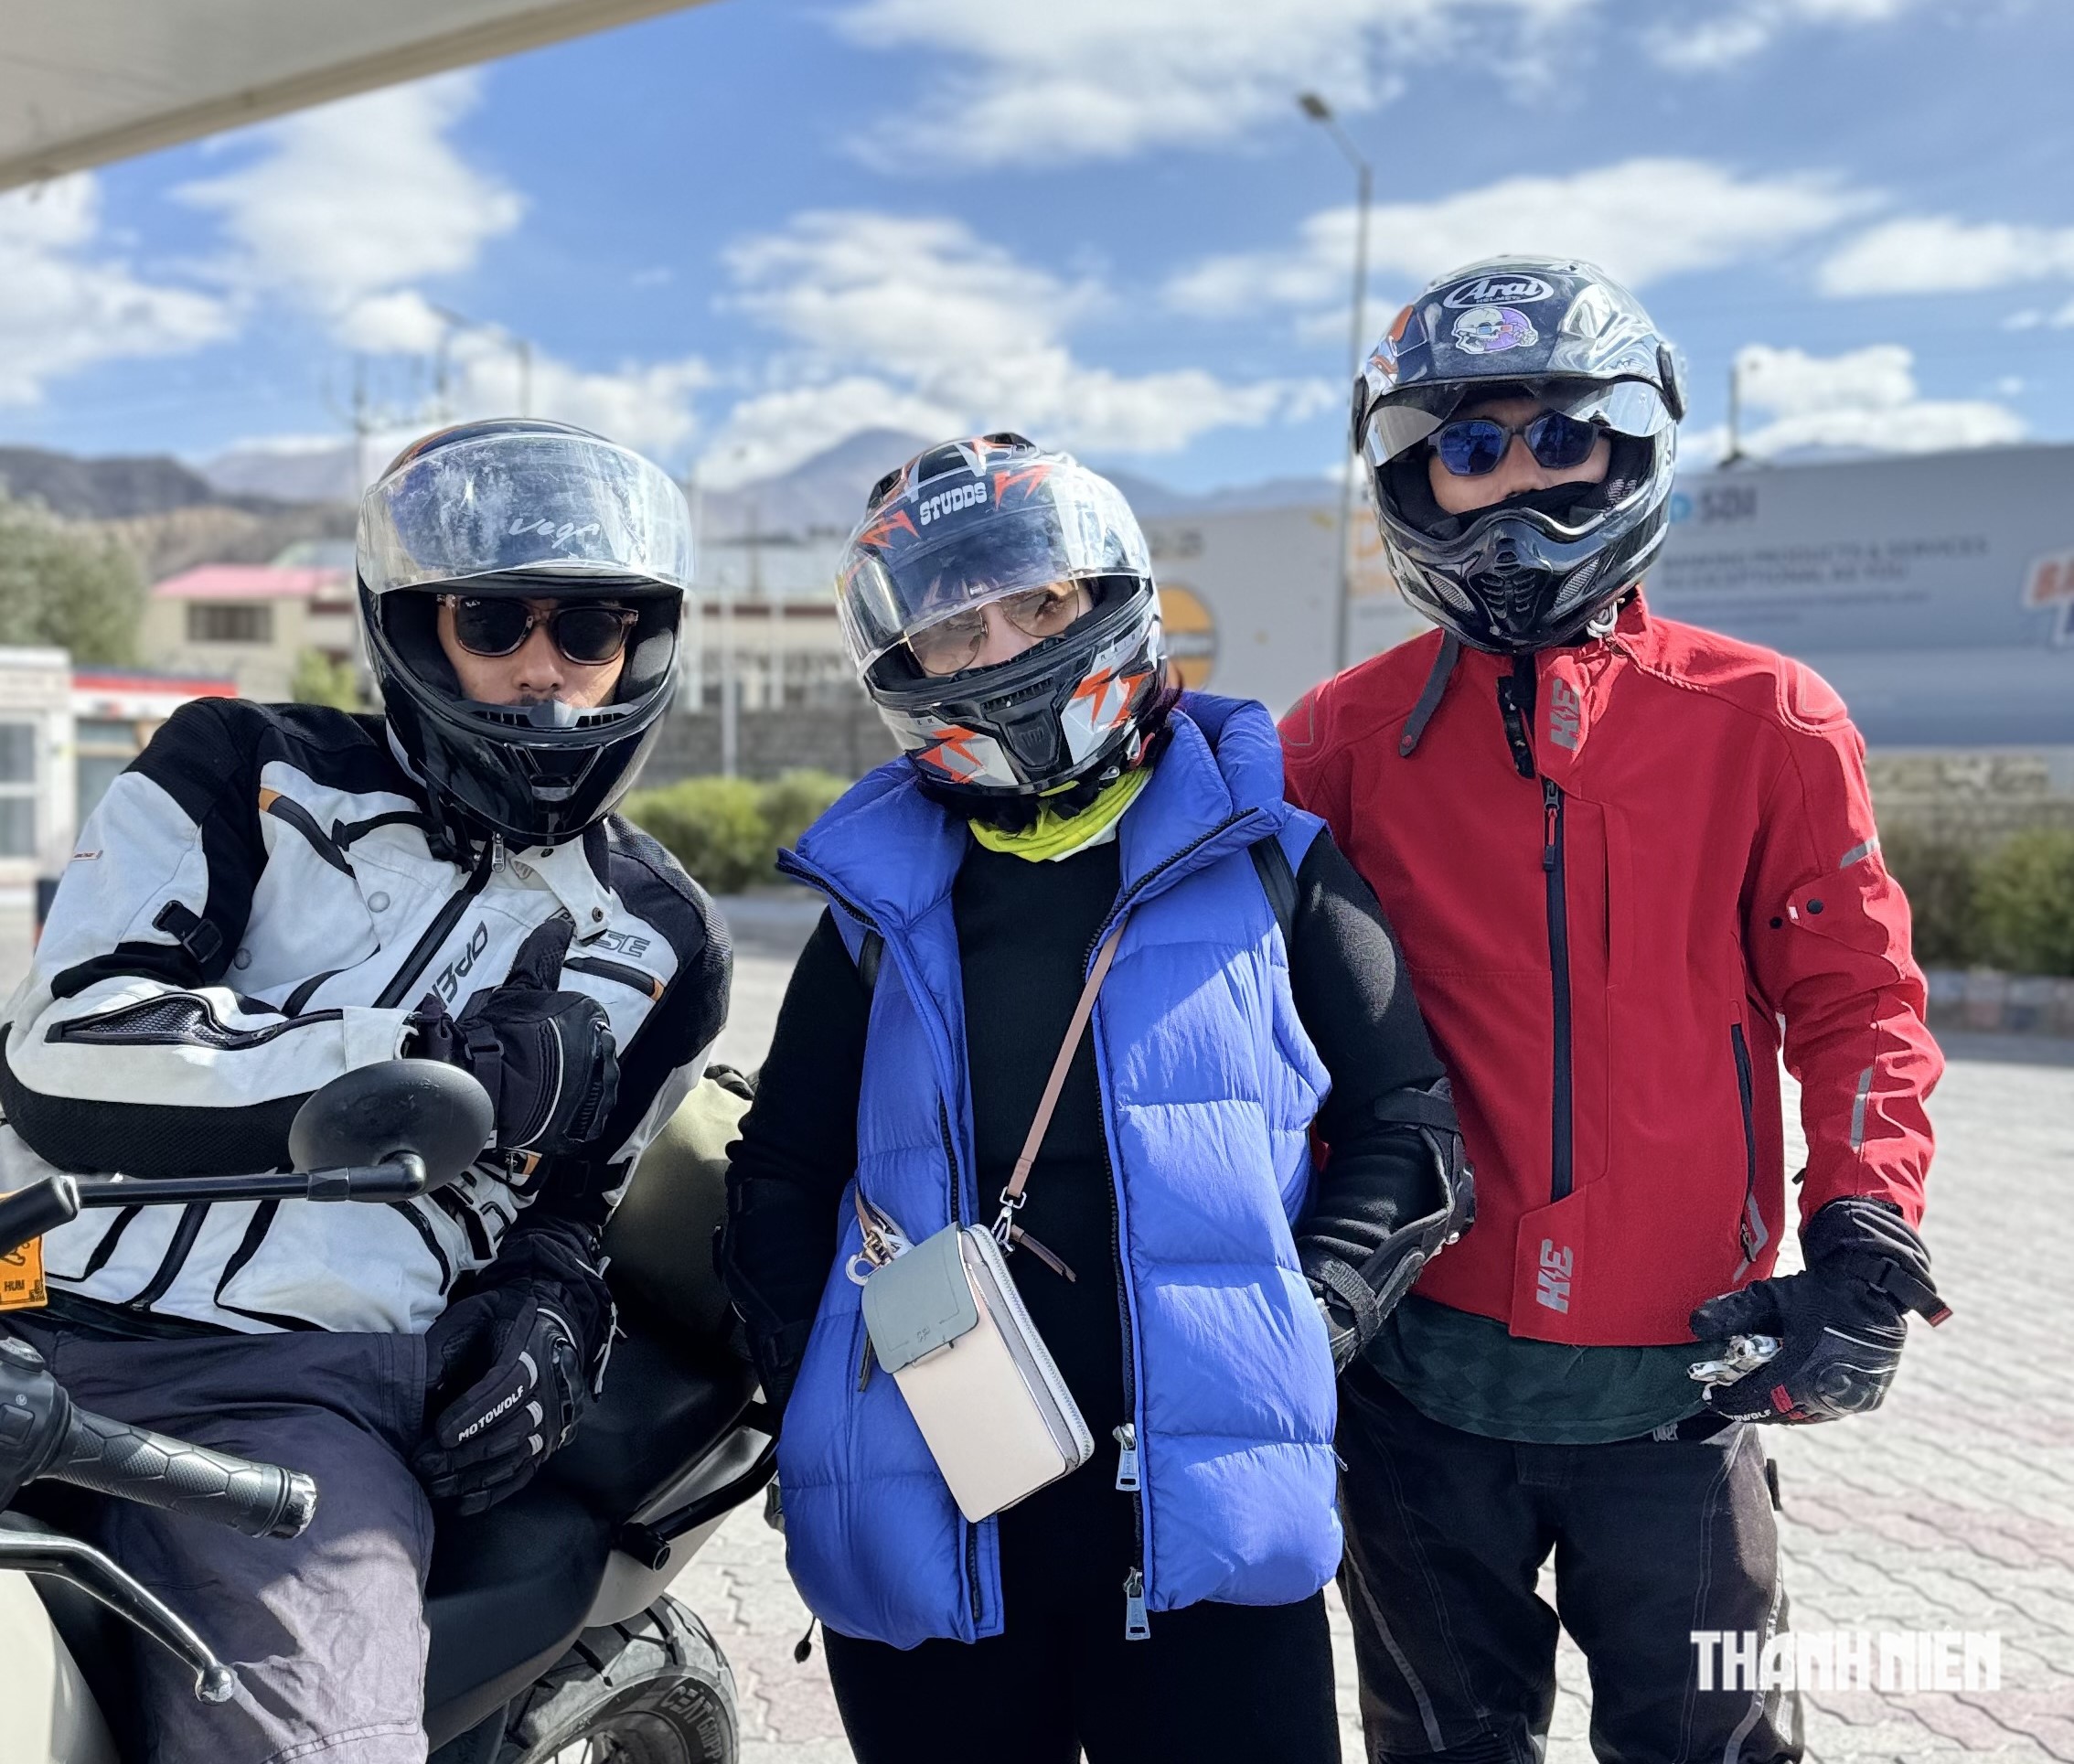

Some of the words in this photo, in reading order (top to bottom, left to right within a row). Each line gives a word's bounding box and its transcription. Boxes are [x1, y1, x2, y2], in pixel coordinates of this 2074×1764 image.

[1451, 279, 1542, 305] Arai
[919, 481, 988, 526] STUDDS
[458, 1384, 524, 1442] MOTOWOLF
[660, 1685, 715, 1725] CEAT
